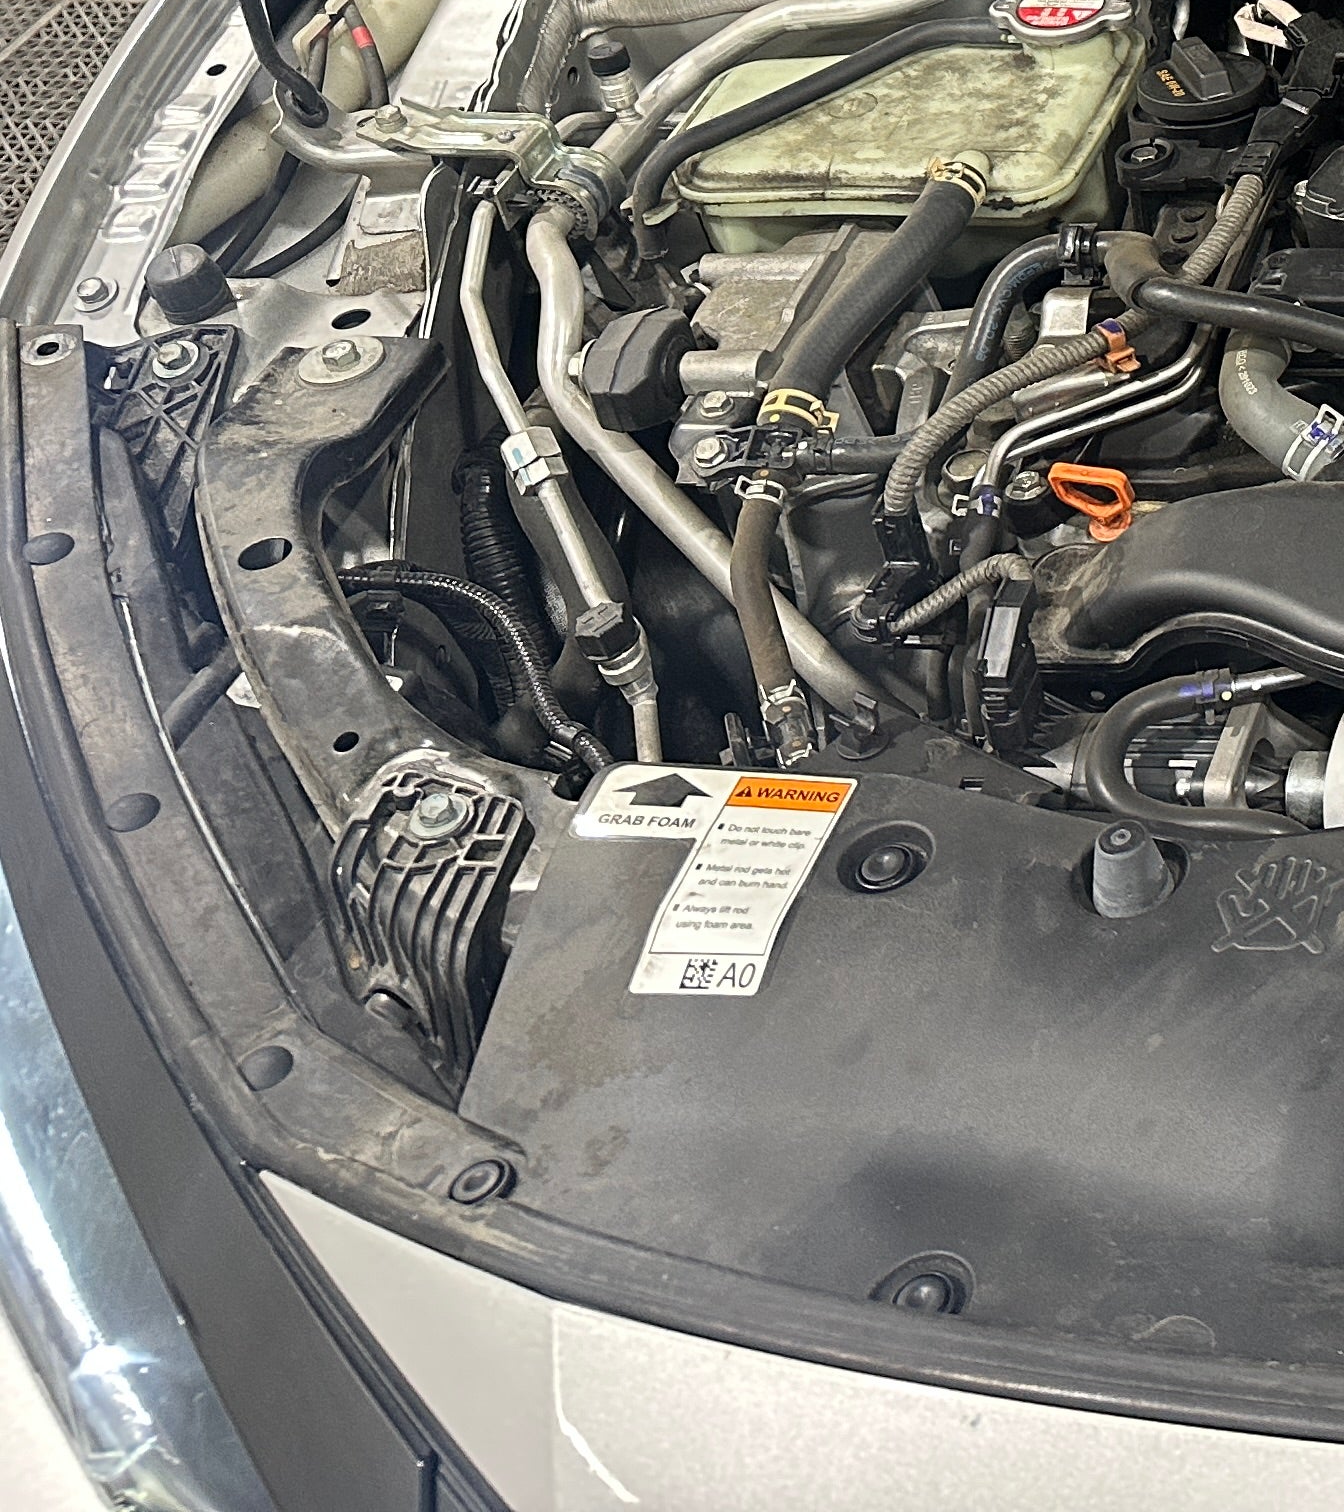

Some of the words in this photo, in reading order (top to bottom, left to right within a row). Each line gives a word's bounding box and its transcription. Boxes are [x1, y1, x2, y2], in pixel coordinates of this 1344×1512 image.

[757, 787, 841, 803] WARNING
[598, 813, 644, 826] GRAB
[647, 816, 696, 829] FOAM
[728, 824, 743, 833] Do
[744, 825, 760, 834] not
[761, 826, 788, 835] touch
[789, 828, 811, 836] bare
[720, 838, 747, 846] metal
[761, 840, 787, 848] white
[706, 864, 733, 872] Metal
[734, 866, 750, 874] rod
[752, 867, 773, 879] gets
[775, 868, 791, 876] hot
[698, 878, 718, 886] and
[738, 880, 761, 888] burn
[682, 904, 717, 914] Always
[732, 906, 750, 915] rod
[676, 920, 702, 931] using
[704, 919, 729, 929] foam
